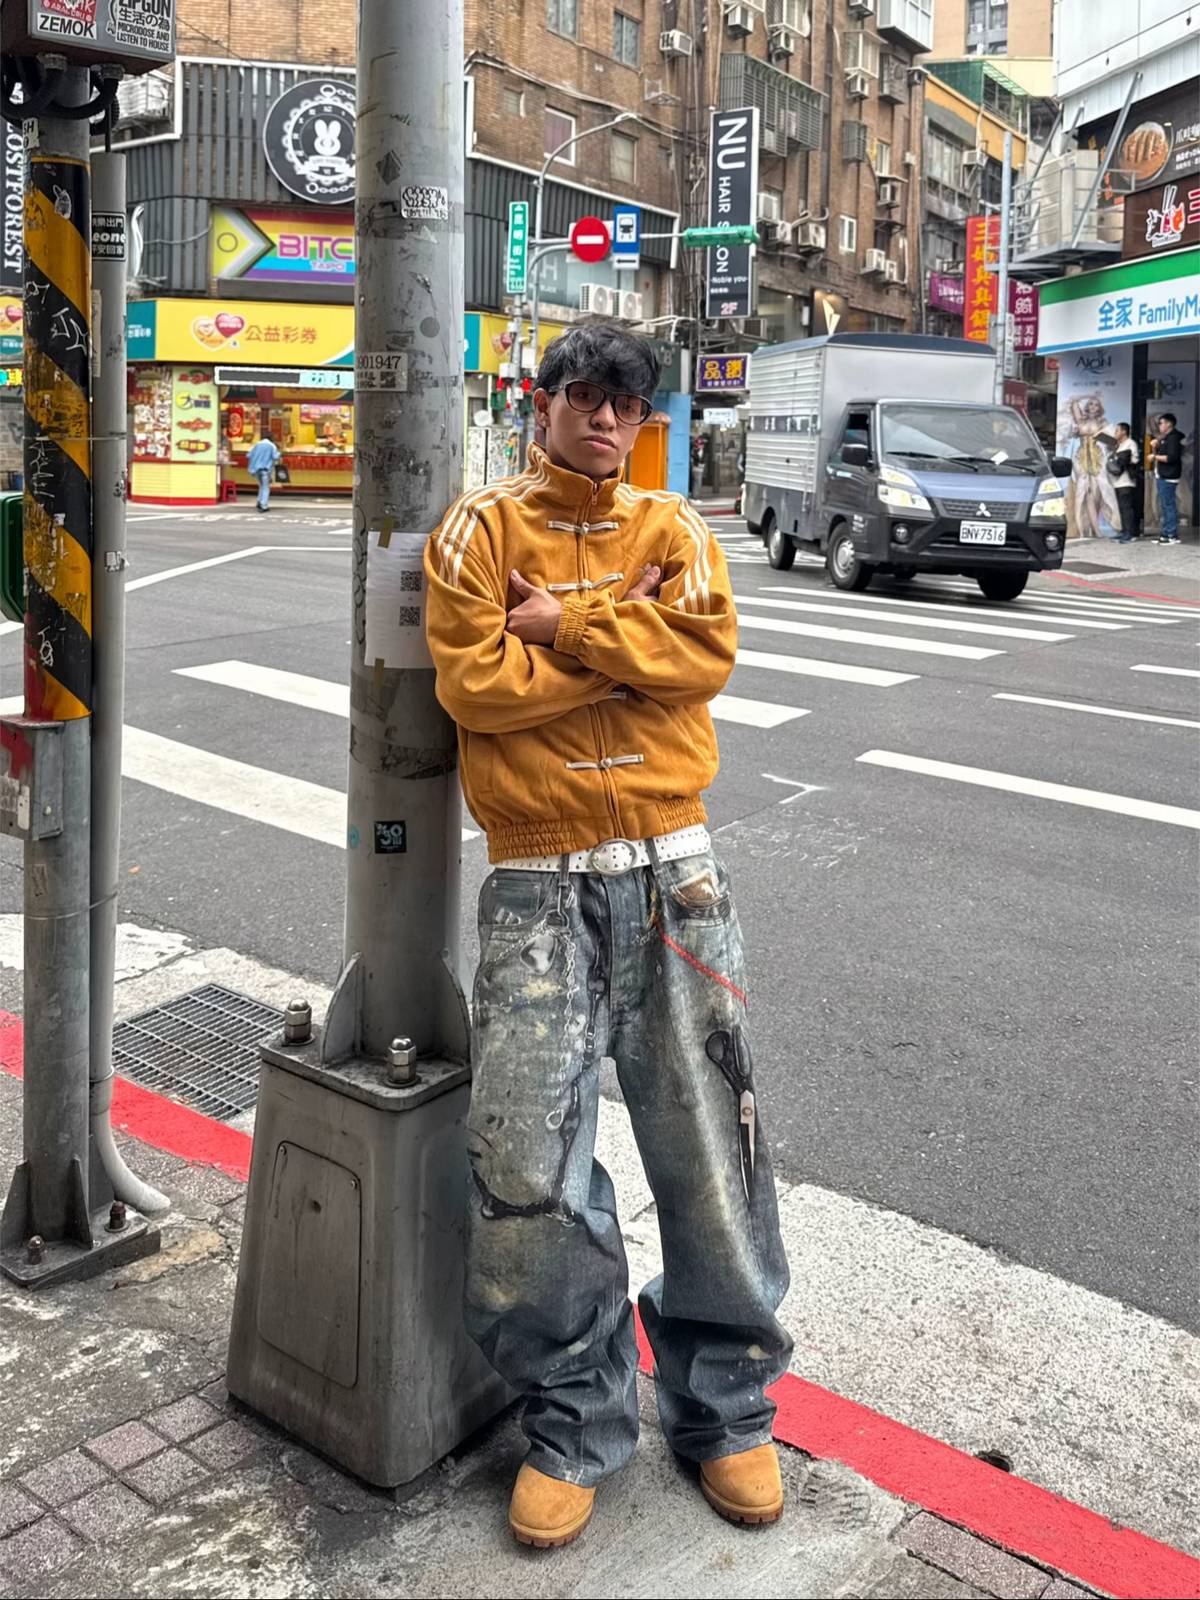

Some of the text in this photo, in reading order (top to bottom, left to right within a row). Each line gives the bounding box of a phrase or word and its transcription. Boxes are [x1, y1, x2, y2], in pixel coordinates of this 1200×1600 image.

[39, 15, 94, 38] ZEMOK
[118, 22, 170, 42] MICRODOSE AND
[117, 32, 170, 51] LISTEN TO HOUSE
[717, 117, 747, 169] NU
[718, 176, 731, 213] HAIR
[720, 302, 738, 315] 2F
[1098, 293, 1200, 331] 全家 FamilyM
[245, 324, 317, 344] 公益彩券
